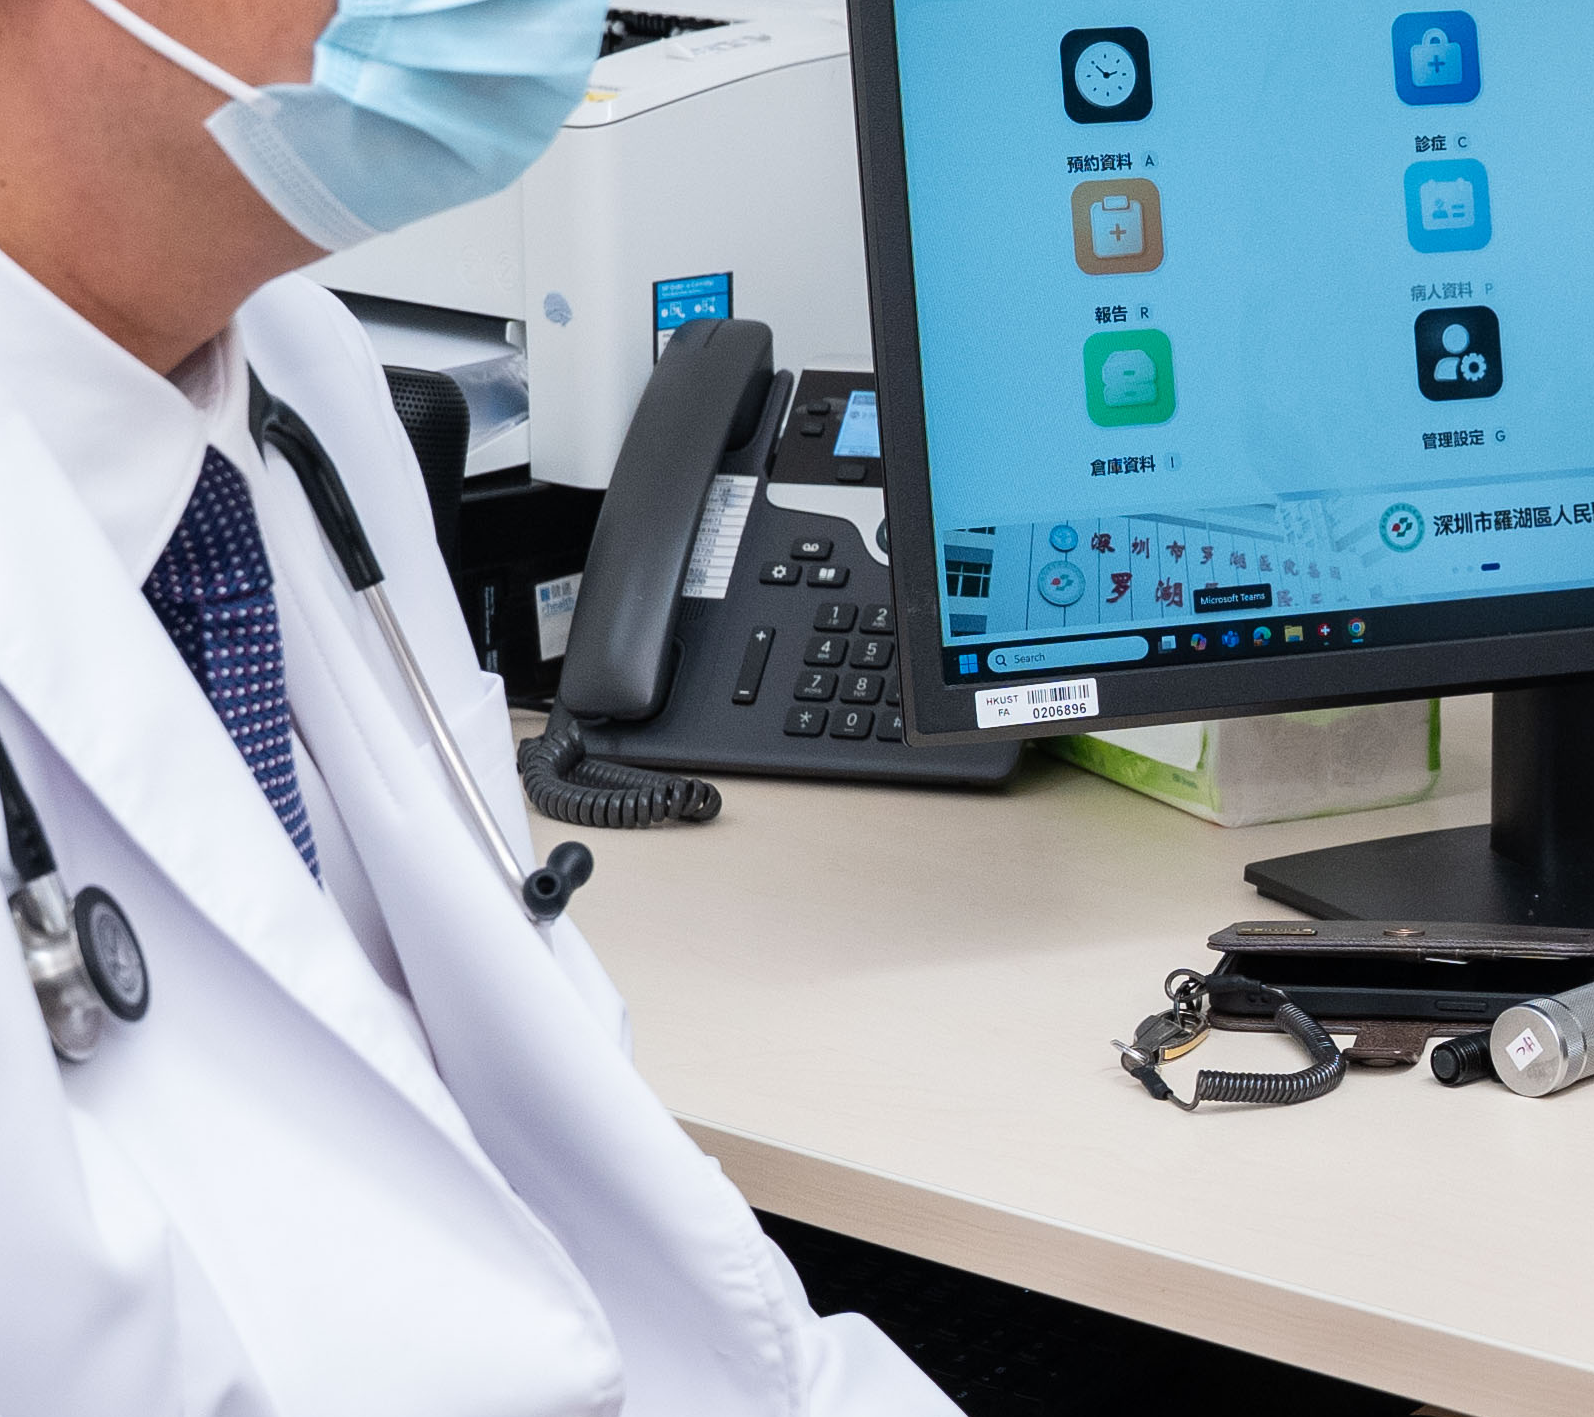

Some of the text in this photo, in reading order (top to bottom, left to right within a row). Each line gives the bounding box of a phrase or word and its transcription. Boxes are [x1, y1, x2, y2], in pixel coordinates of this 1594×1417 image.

[1415, 135, 1468, 152] 診症 C
[1067, 153, 1154, 173] 預約資料 A
[1411, 282, 1493, 302] 病人資料 P
[1095, 305, 1149, 324] 報告 R
[1423, 430, 1506, 450] 管理設定 G
[1090, 455, 1156, 476] 倉庫資料
[1200, 593, 1238, 606] Microsoft
[1241, 590, 1266, 602] Teams
[833, 607, 838, 618] 1
[876, 608, 887, 621] 2
[821, 641, 831, 652] 4
[866, 643, 877, 655] 5
[1014, 651, 1045, 663] Search
[812, 675, 821, 687] 7
[856, 677, 867, 691] 8
[986, 694, 1019, 706] HKUST
[998, 708, 1010, 716] FA
[1033, 702, 1087, 719] 0206896
[847, 713, 858, 726] 0
